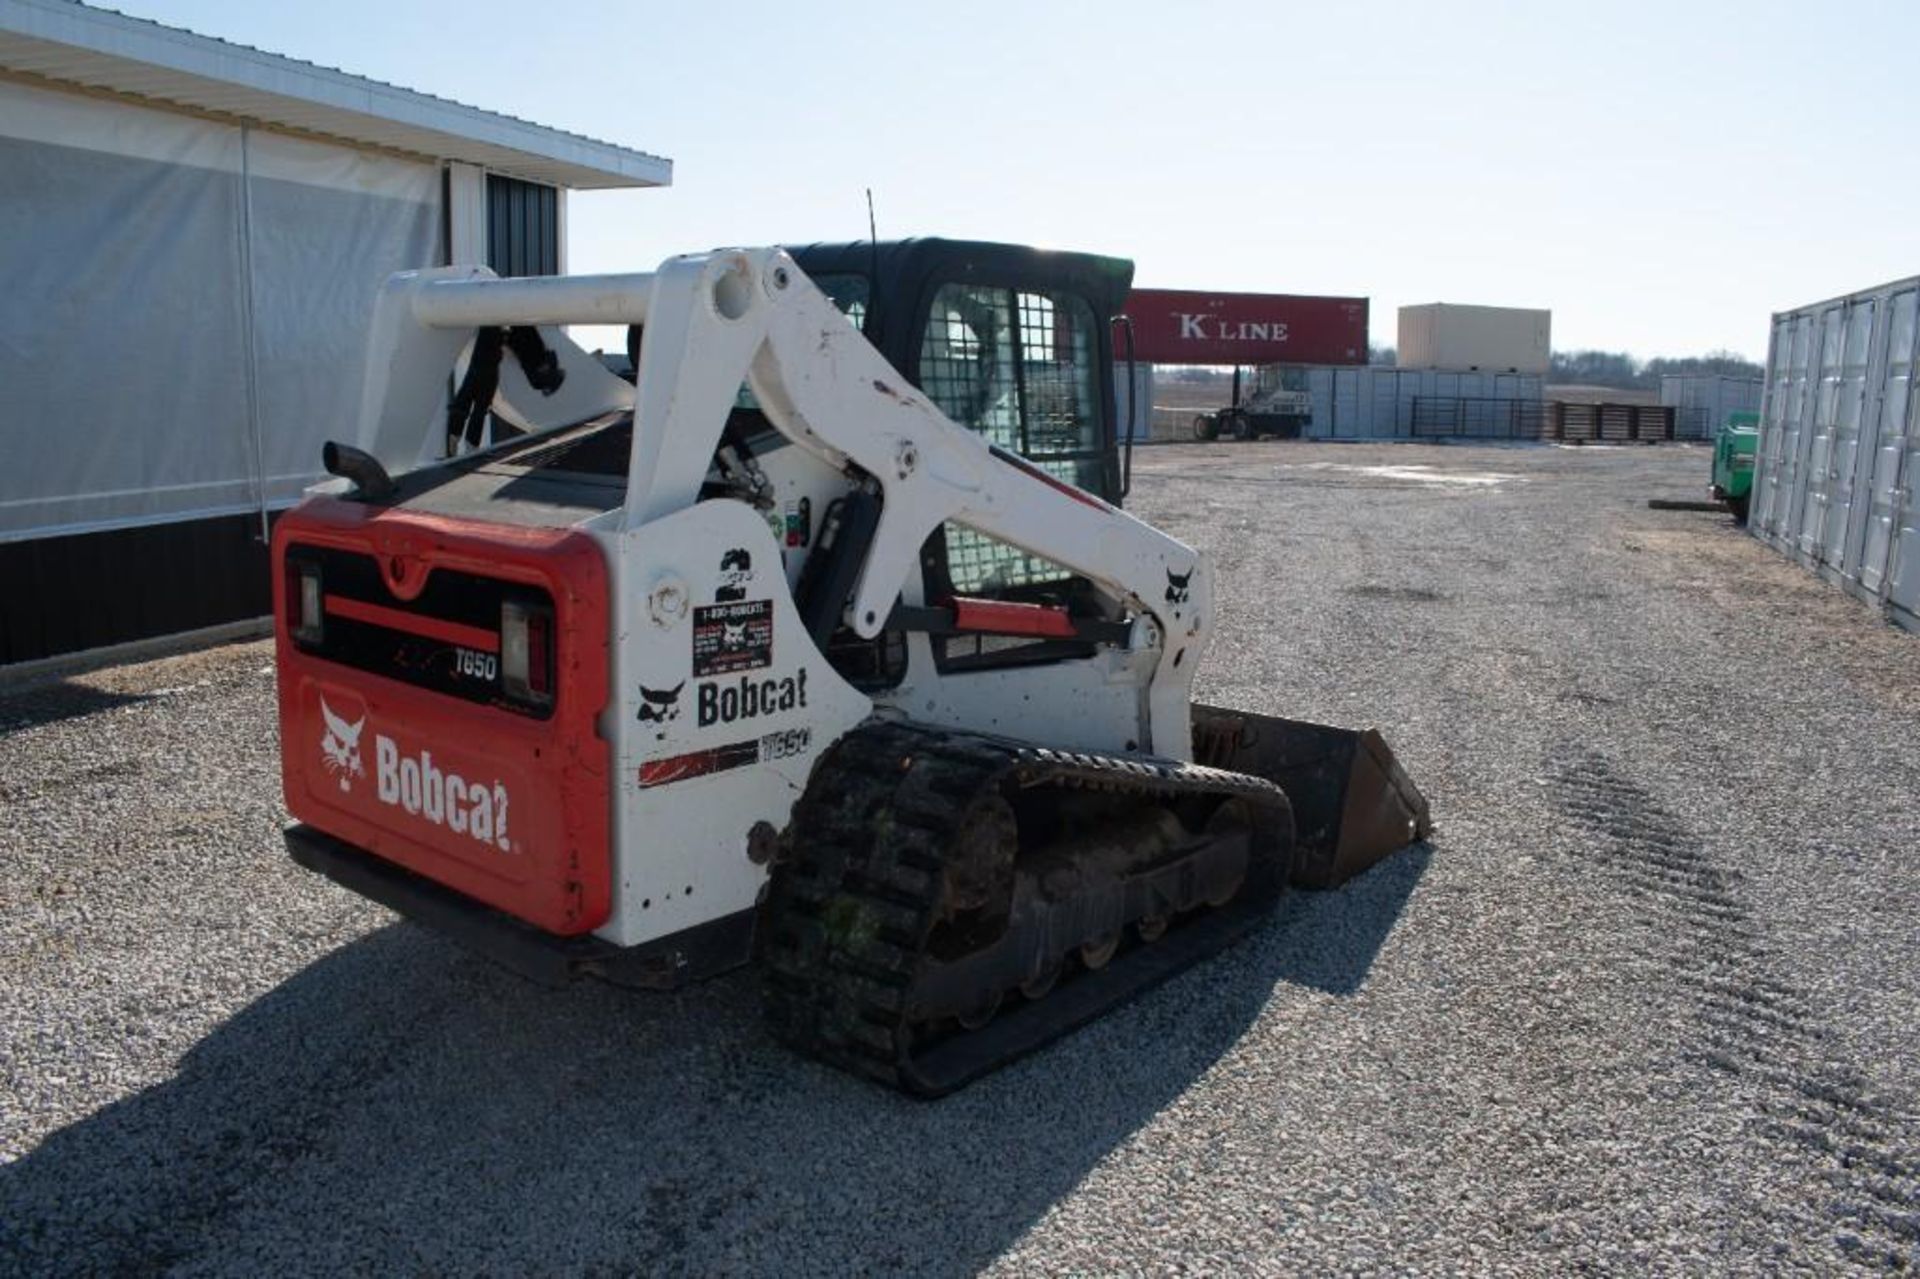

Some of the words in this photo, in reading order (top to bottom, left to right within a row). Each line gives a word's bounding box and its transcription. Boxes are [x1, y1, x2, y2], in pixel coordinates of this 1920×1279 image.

[1220, 322, 1288, 341] LINE
[456, 648, 497, 680] T650
[698, 667, 807, 727] Bobcat
[376, 734, 510, 851] Bobcat
